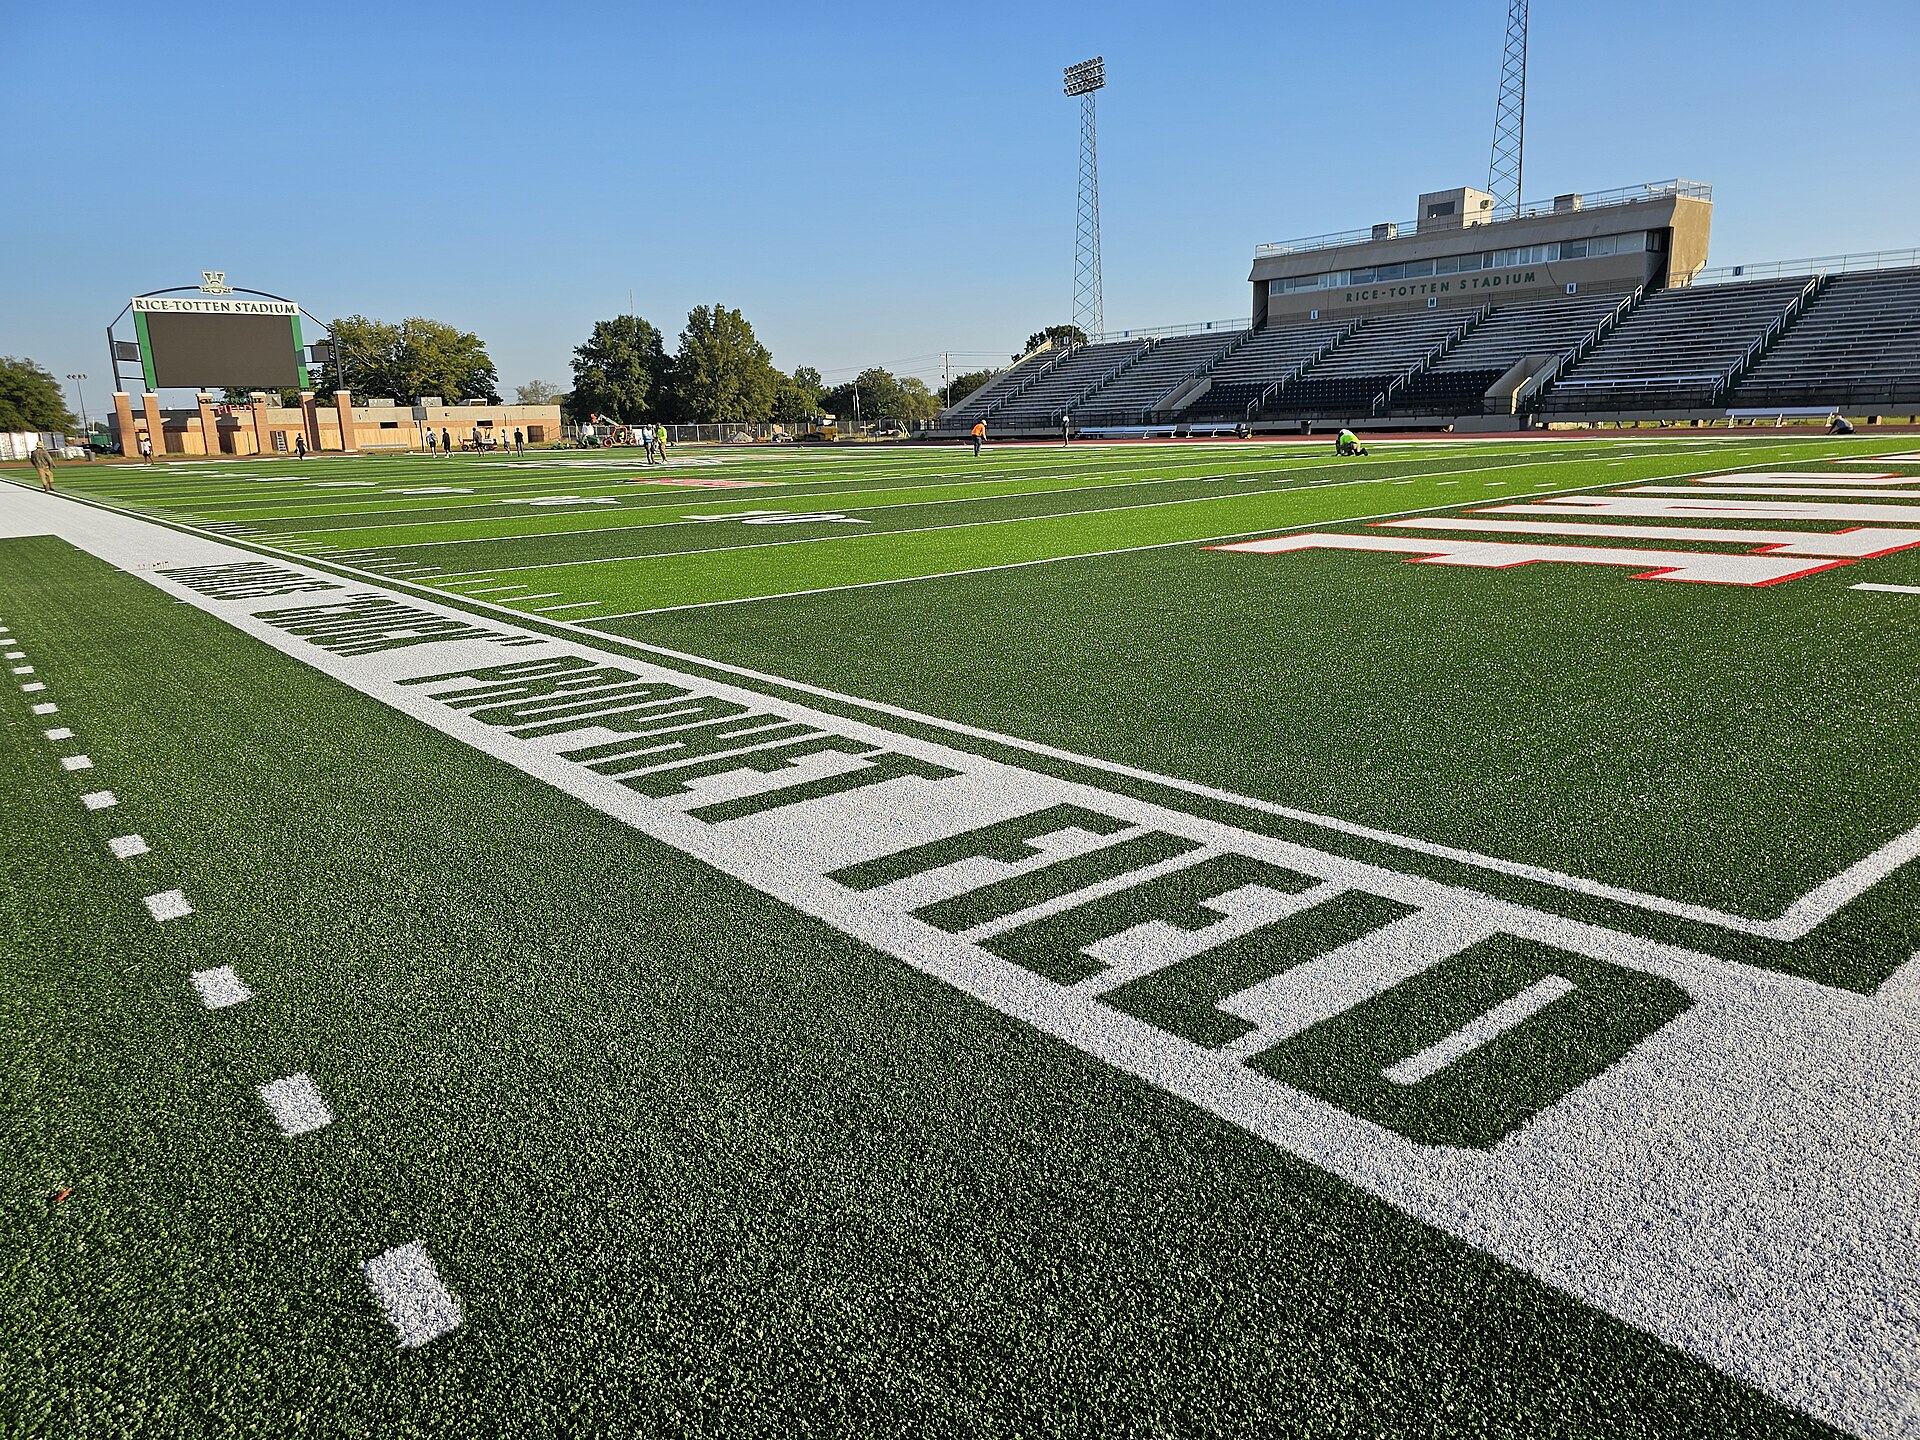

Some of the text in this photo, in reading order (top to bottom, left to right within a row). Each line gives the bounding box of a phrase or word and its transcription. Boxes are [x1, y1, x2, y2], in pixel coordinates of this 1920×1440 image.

[1345, 271, 1536, 302] RICE-TOTTEN STADIUM
[135, 300, 296, 314] RICE-TOTTEN STADIUM
[393, 655, 966, 824] PROPHET
[822, 801, 1695, 1150] FIELD
